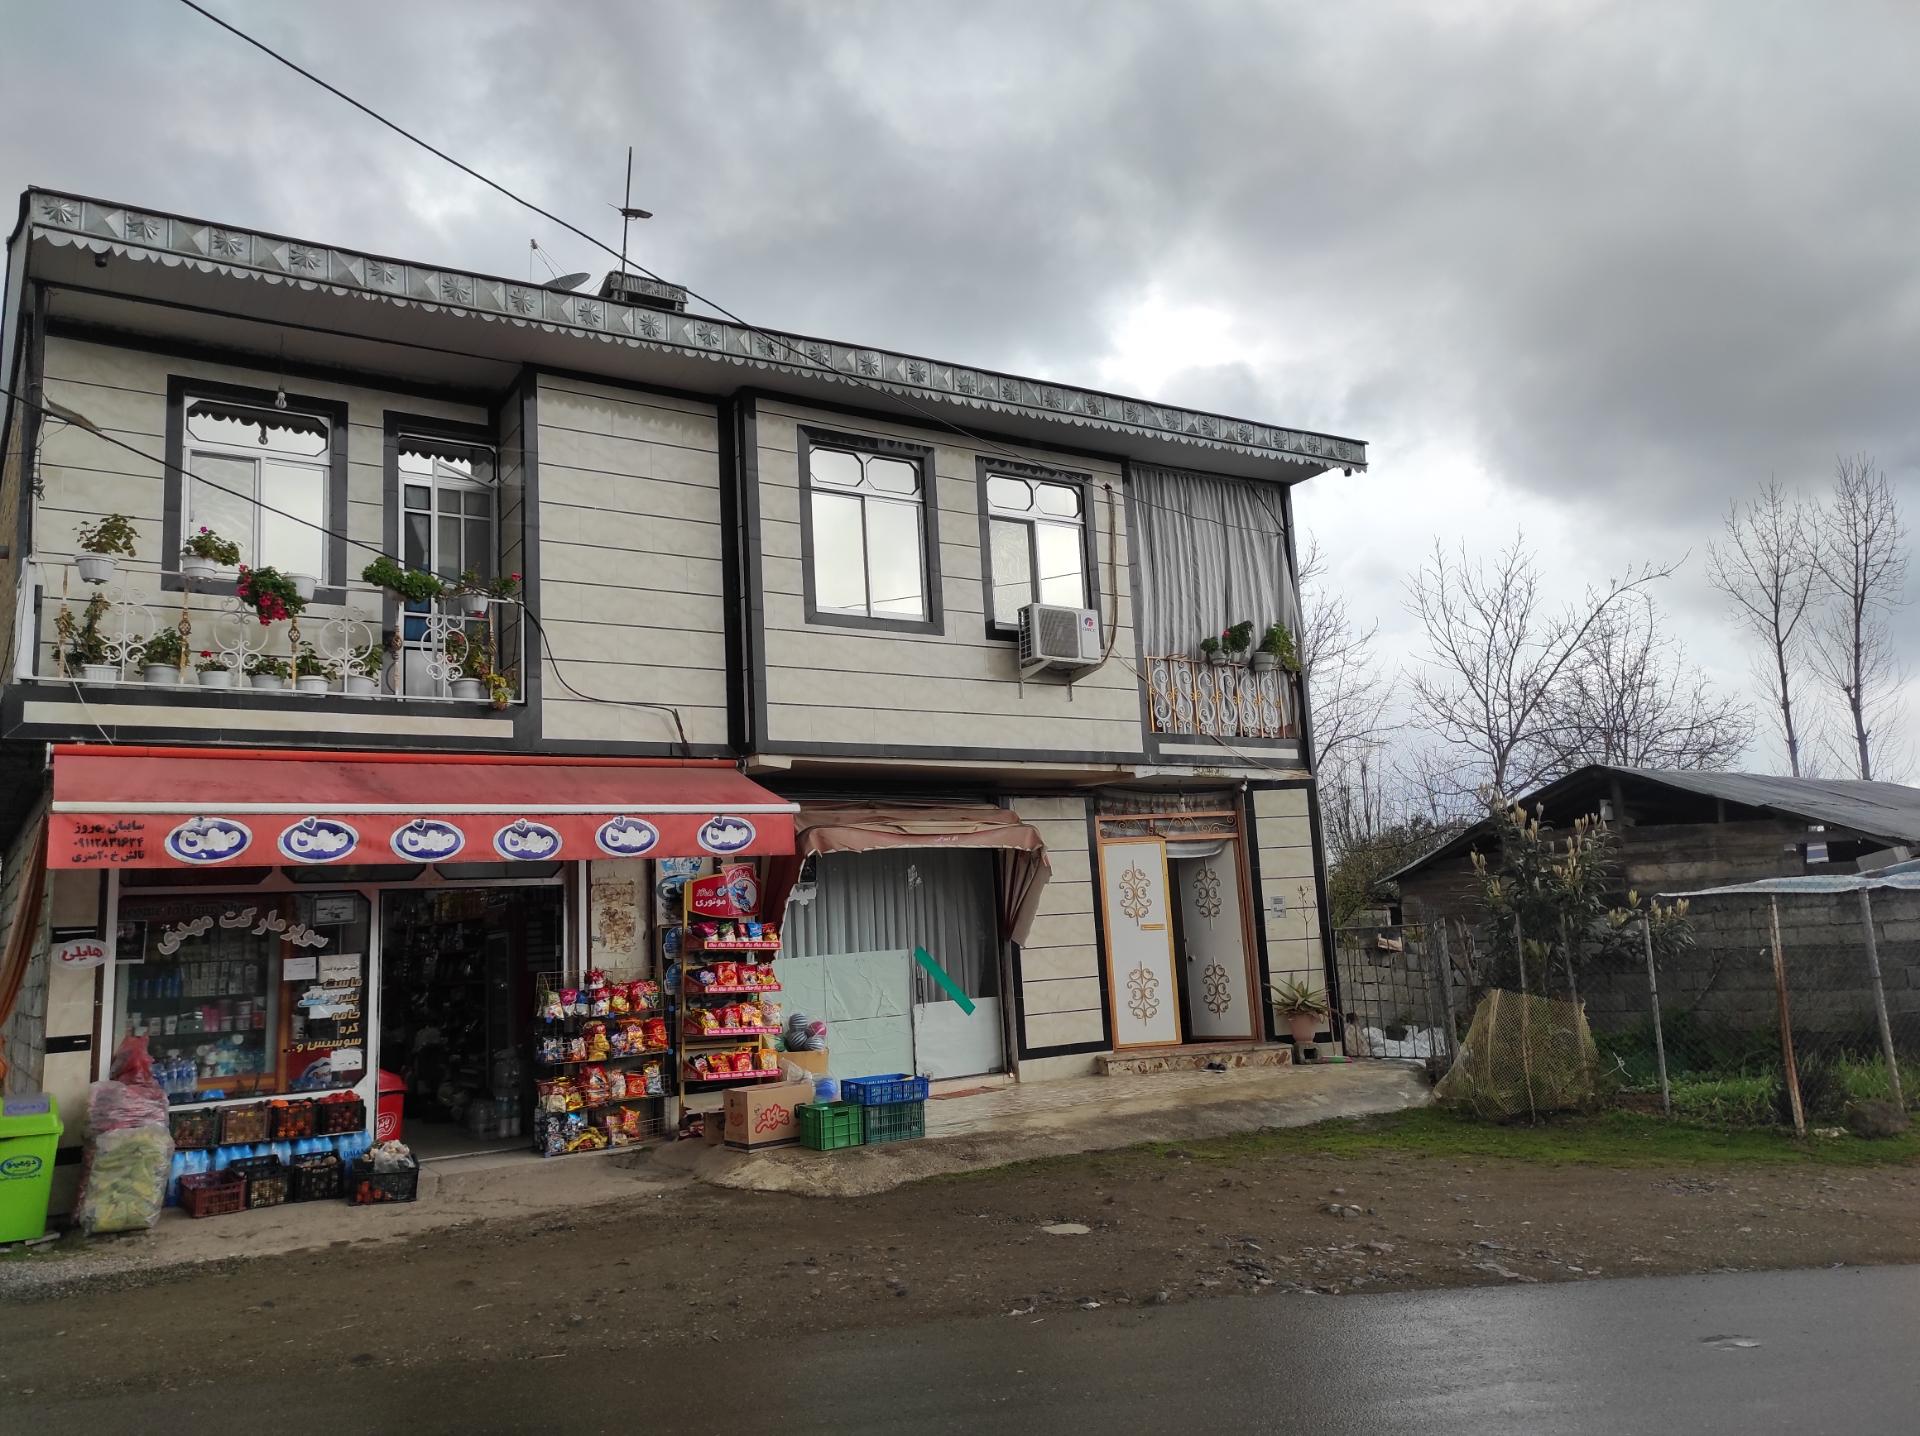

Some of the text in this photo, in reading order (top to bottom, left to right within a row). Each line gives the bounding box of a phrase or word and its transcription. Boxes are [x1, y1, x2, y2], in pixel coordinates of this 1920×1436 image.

[73, 819, 145, 834] سایبان بهروز
[695, 897, 727, 907] موتوری
[322, 977, 362, 989] ماست
[336, 992, 360, 1006] پنیر
[331, 1009, 361, 1021] خامه
[339, 1022, 360, 1035] کره
[307, 1037, 362, 1051] سوسیس
